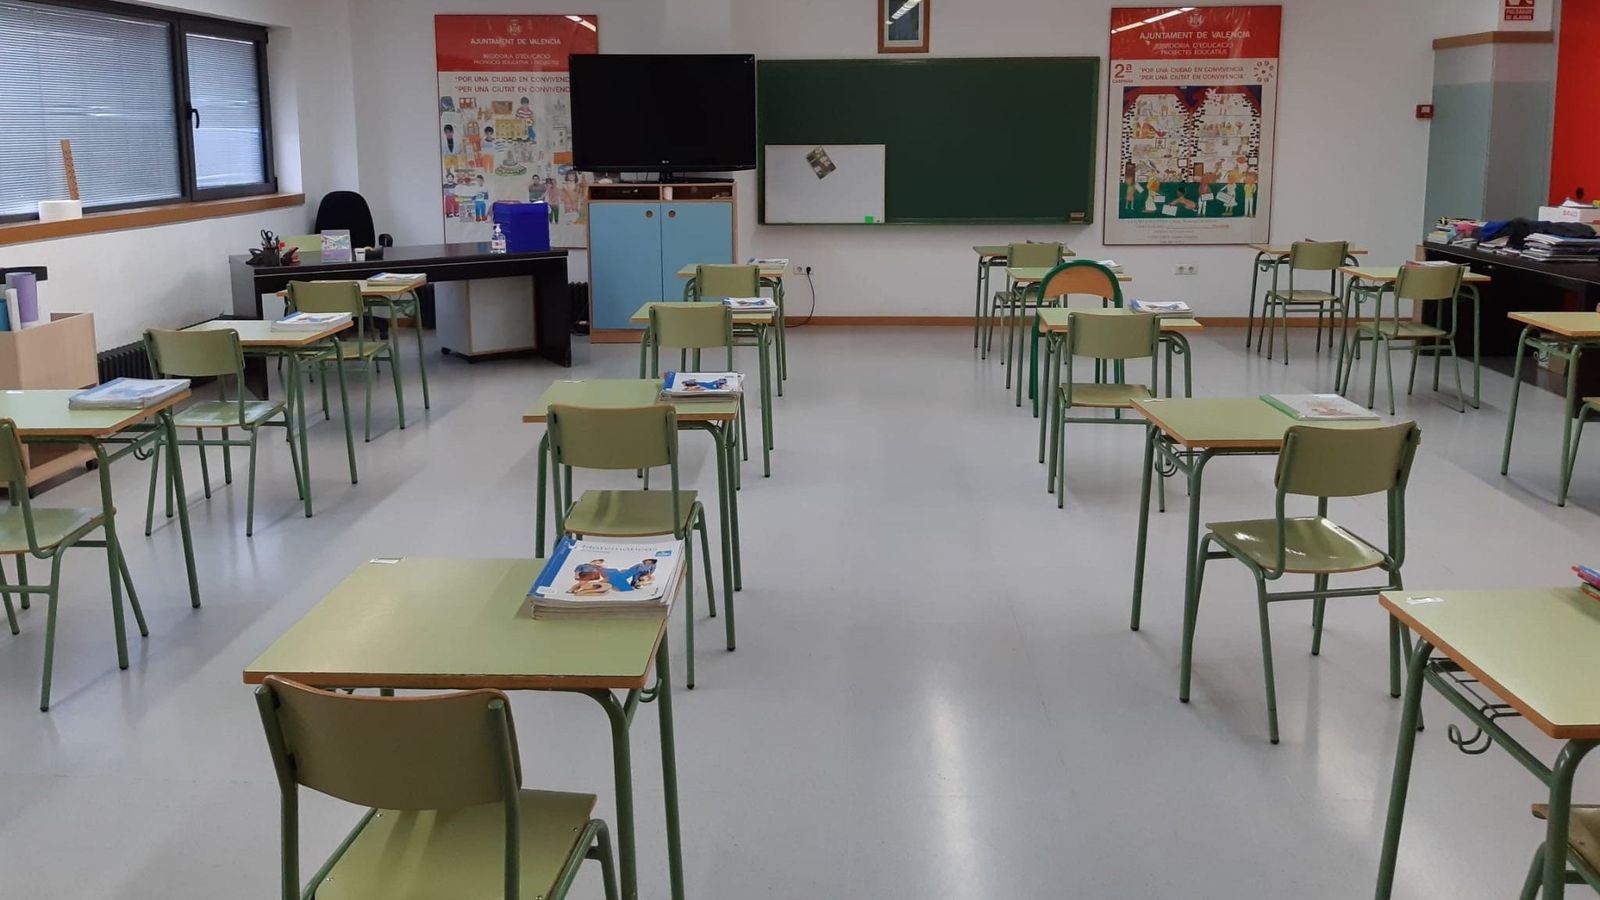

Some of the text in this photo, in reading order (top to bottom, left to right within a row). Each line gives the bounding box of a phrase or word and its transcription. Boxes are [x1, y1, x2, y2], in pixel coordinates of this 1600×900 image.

[1139, 31, 1251, 39] AJUNTAMENT DE VALENCIA
